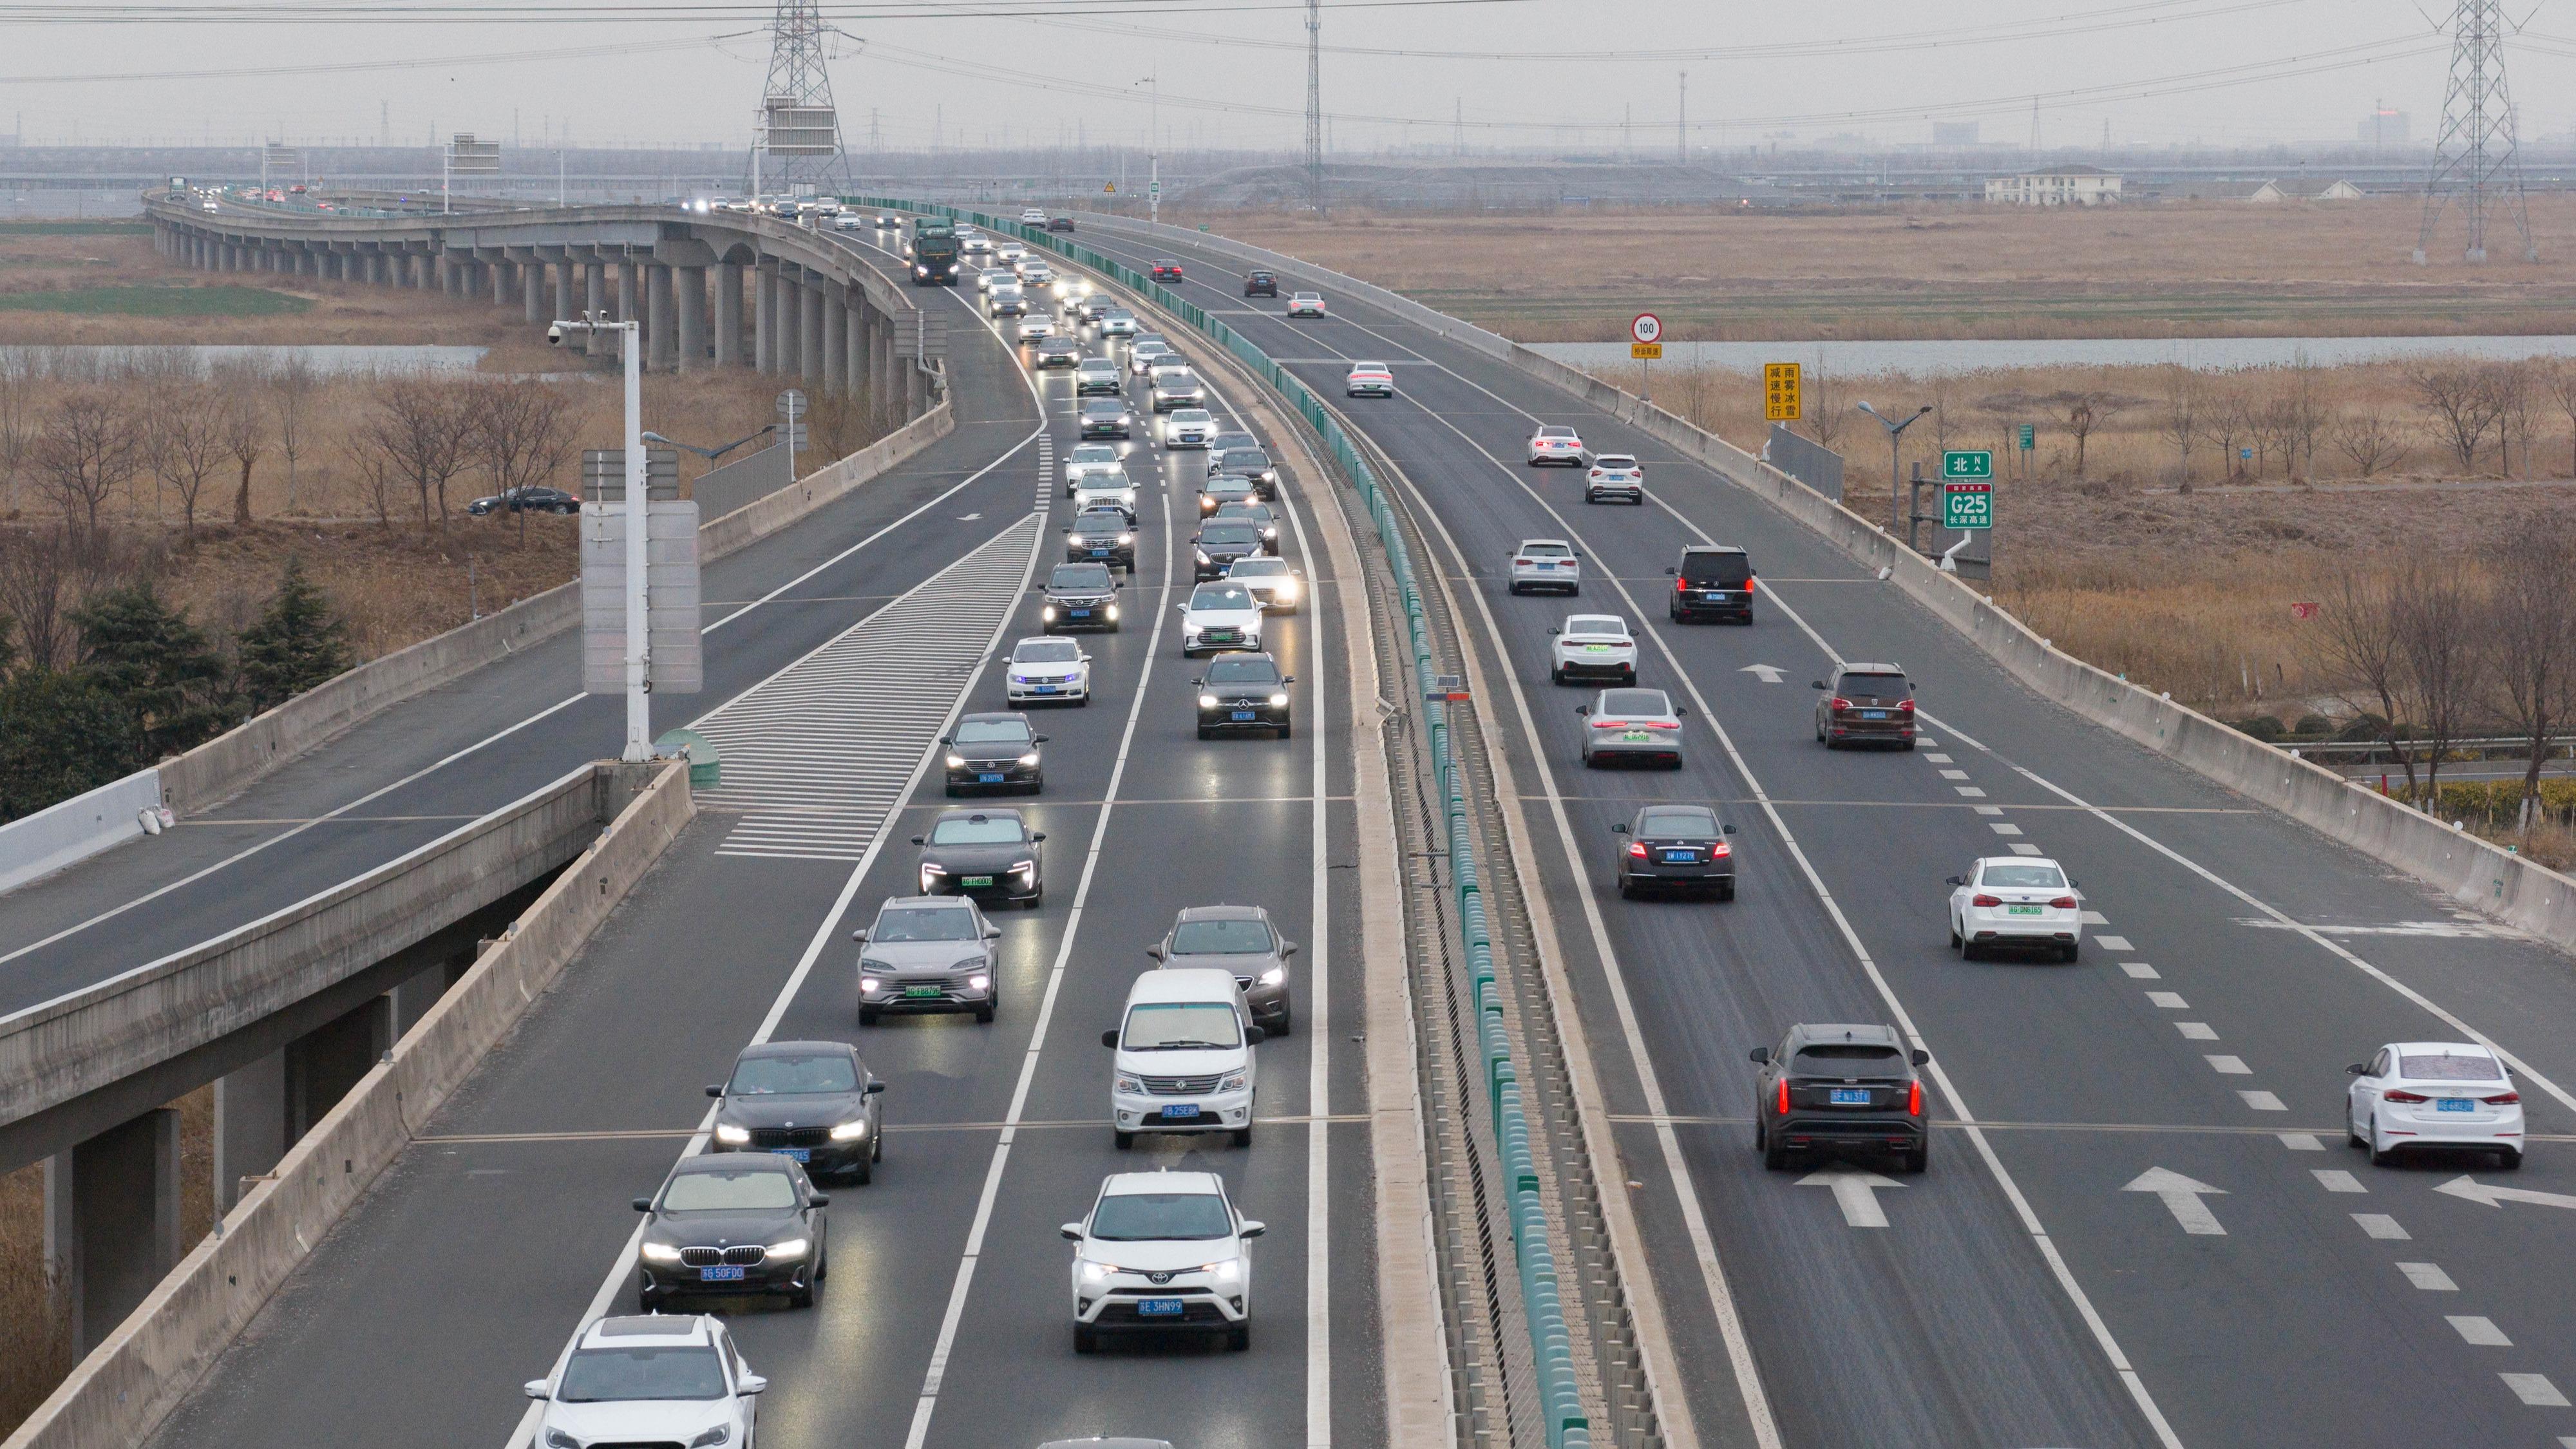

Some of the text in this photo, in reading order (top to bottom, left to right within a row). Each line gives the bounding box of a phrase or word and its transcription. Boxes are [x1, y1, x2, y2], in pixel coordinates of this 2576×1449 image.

[1640, 323, 1654, 334] 100
[1770, 367, 1781, 417] 减速慢行
[1785, 367, 1795, 416] 雨雾冰雪
[1953, 455, 1980, 472] 北 N
[1951, 495, 1987, 513] G25
[1949, 516, 1987, 524] 长深高速
